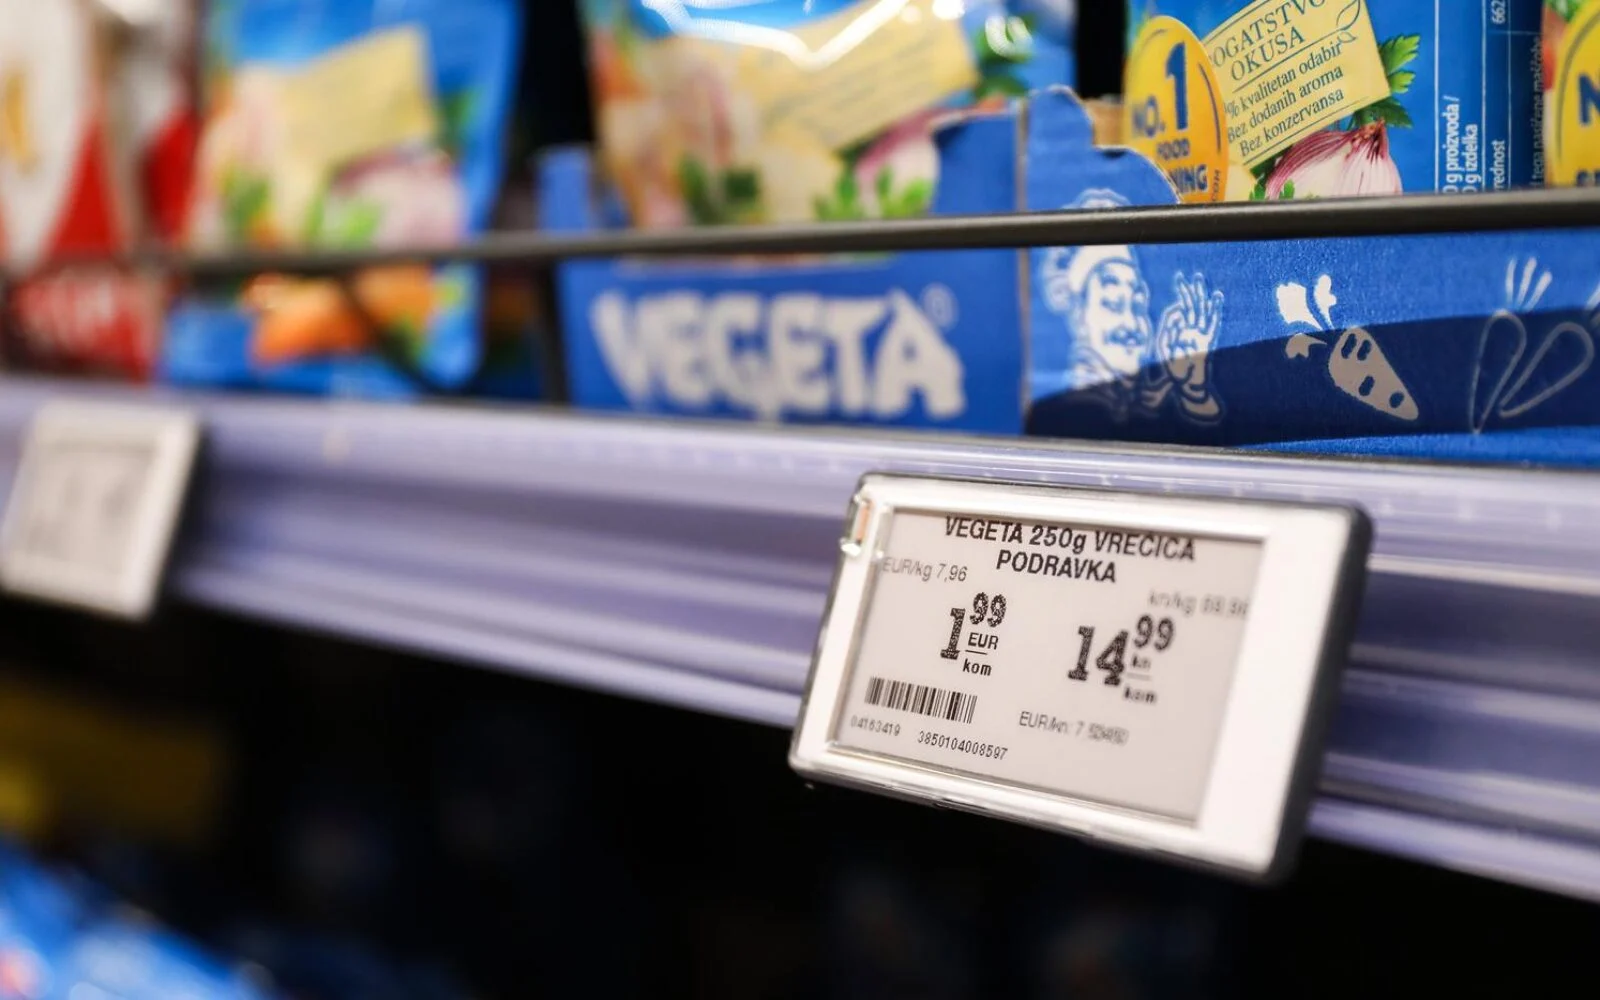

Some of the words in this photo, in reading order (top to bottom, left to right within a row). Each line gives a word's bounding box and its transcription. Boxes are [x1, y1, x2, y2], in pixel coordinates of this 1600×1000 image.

[1209, 0, 1326, 67] OGATSTV
[1231, 26, 1305, 81] OKUSA
[1166, 41, 1188, 130] 1
[1240, 68, 1296, 113] kvalitetan
[1299, 39, 1342, 74] odabir
[1250, 91, 1297, 128] dodanih
[1300, 66, 1343, 98] aroma
[1240, 137, 1262, 157] Bez
[1264, 89, 1344, 142] konzervansa
[1442, 104, 1465, 171] proizvoda
[1462, 124, 1478, 172] izdelka
[592, 289, 965, 421] VEGETA
[945, 516, 1022, 544] VEGETA
[1029, 524, 1087, 554] 250g
[882, 556, 933, 582] EUR/kg
[936, 563, 968, 582] 7,96
[996, 549, 1116, 583] PODRAVKA
[941, 607, 966, 660] 1
[970, 592, 1007, 627] 99
[968, 632, 999, 650] EUR
[1067, 625, 1129, 686] 14
[1134, 614, 1174, 652] 99
[963, 658, 992, 676] kom
[850, 714, 901, 737] 04163419
[918, 730, 1009, 760] 3850104008597
